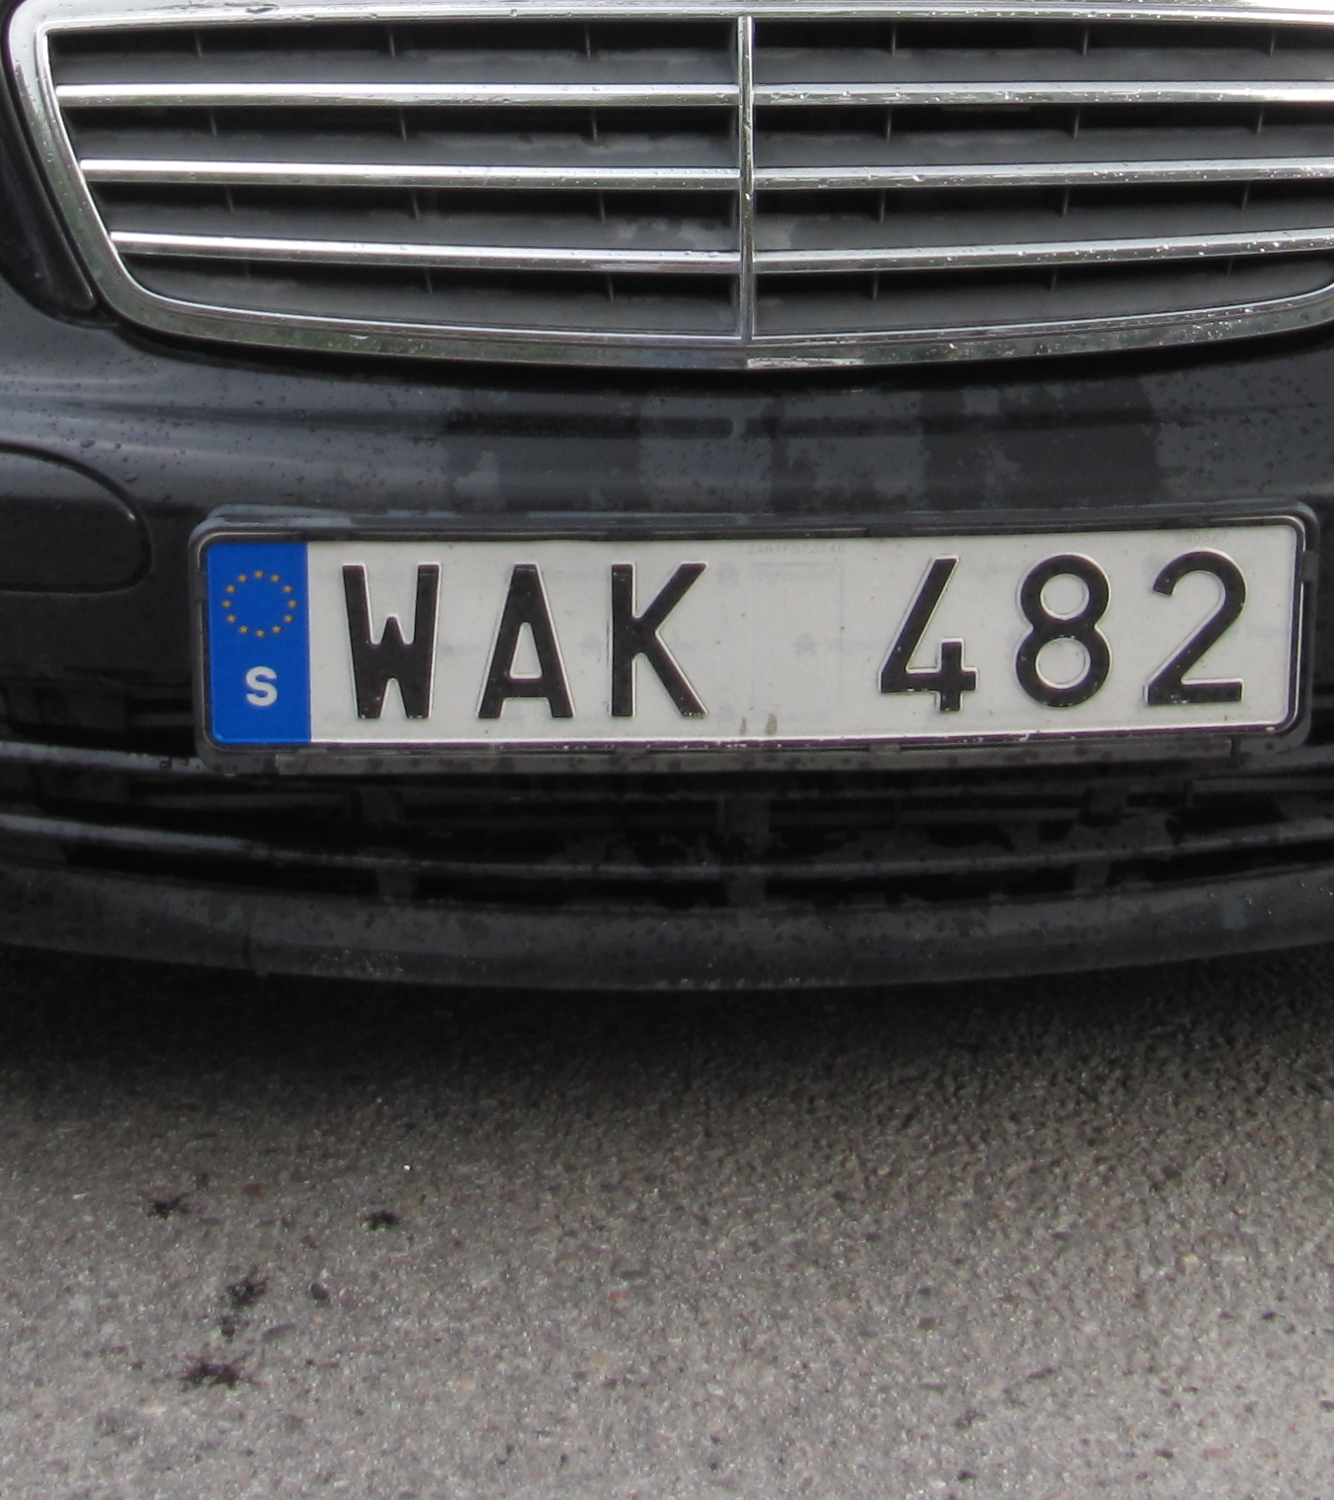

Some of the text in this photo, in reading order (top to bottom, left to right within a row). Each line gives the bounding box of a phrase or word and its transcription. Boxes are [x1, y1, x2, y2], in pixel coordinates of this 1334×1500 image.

[245, 665, 279, 707] S
[342, 551, 1246, 720] WAK 482
